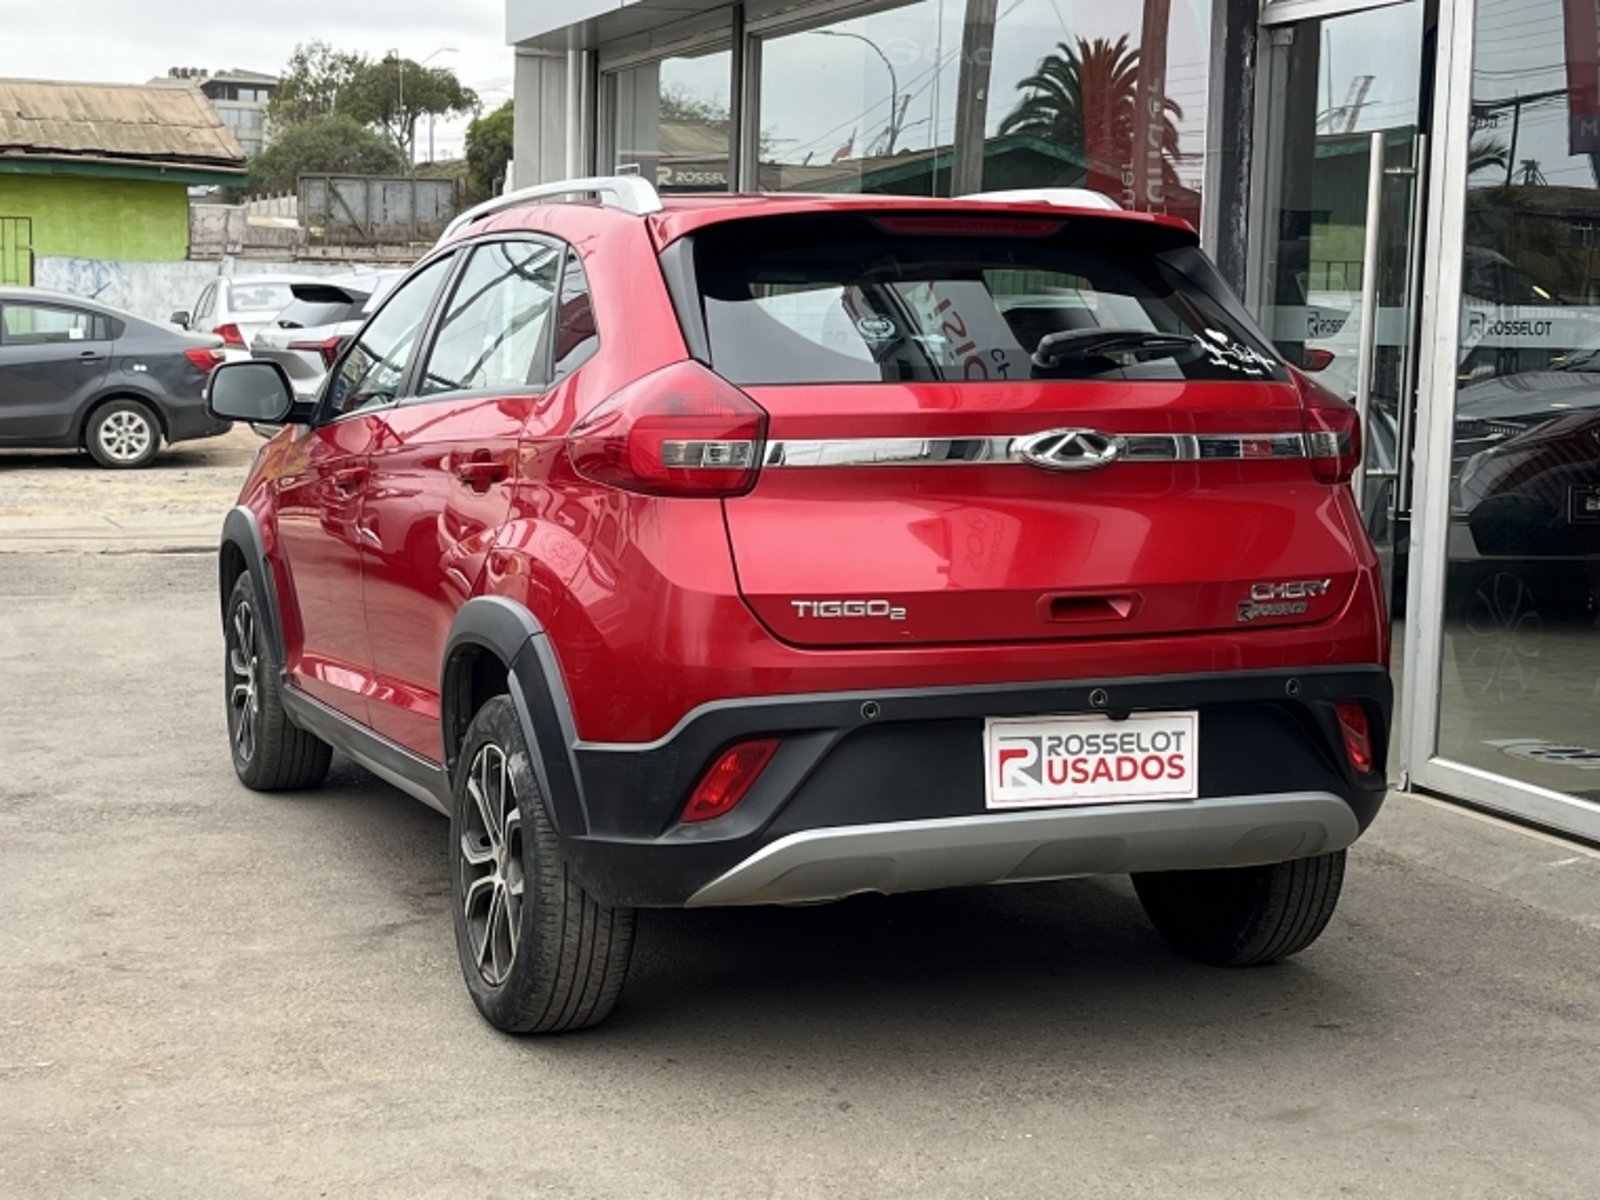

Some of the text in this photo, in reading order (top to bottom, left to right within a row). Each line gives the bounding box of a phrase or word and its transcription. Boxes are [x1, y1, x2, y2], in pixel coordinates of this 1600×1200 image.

[1486, 320, 1552, 336] ROSSELOT
[1251, 579, 1332, 600] CHERY
[1047, 731, 1186, 756] ROSSELOT
[1047, 754, 1186, 785] USADOS
